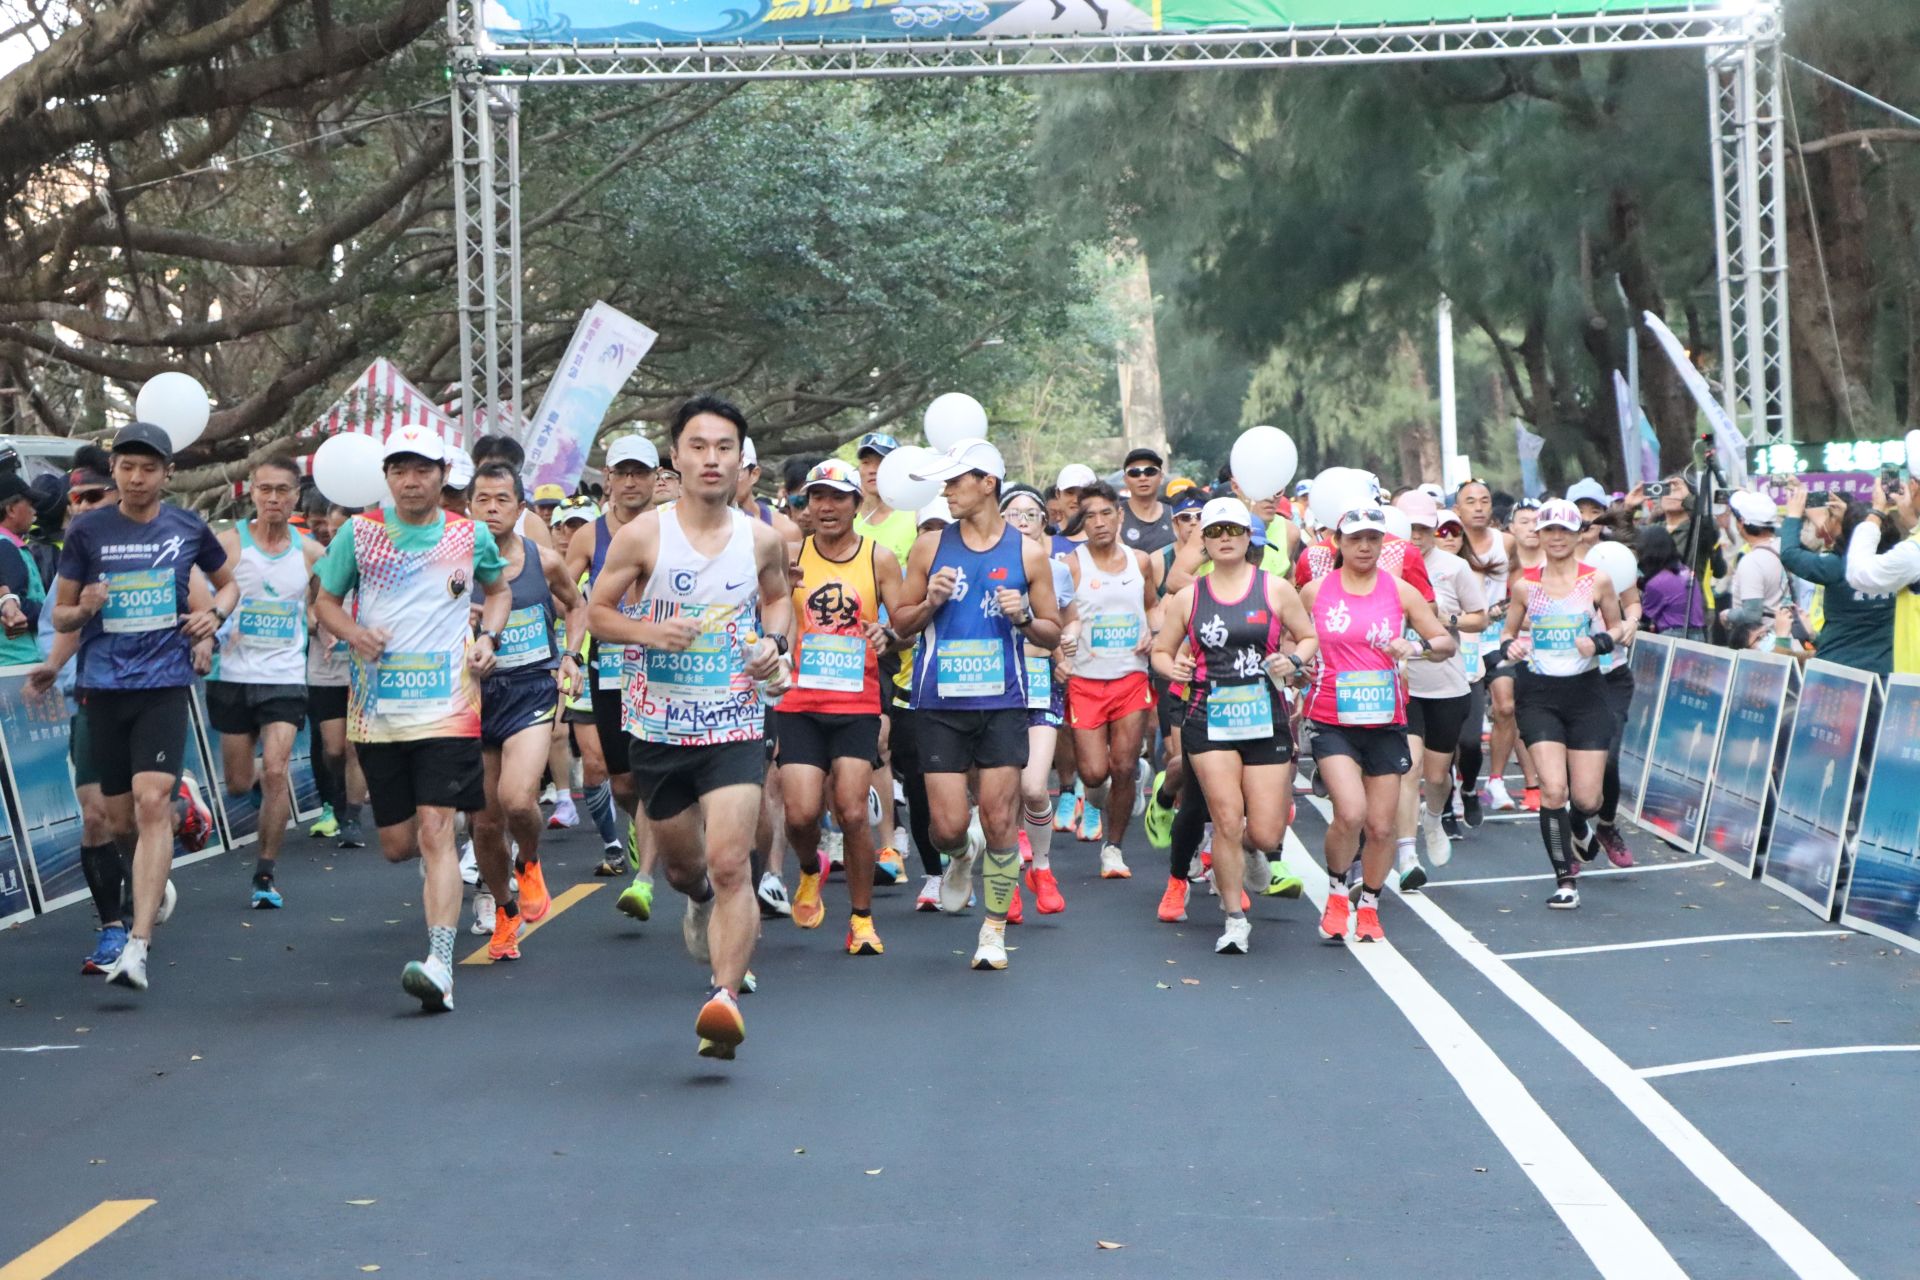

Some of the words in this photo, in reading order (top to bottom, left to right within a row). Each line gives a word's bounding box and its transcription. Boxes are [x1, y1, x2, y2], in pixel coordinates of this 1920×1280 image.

[242, 614, 294, 630] 乙30278
[500, 622, 543, 645] 30289
[651, 653, 727, 673] 戊30363
[803, 651, 861, 669] 乙30032
[940, 657, 1001, 673] 丙30034
[381, 671, 446, 688] 乙30031
[1339, 687, 1393, 703] 甲40012
[1210, 701, 1269, 718] 乙40013
